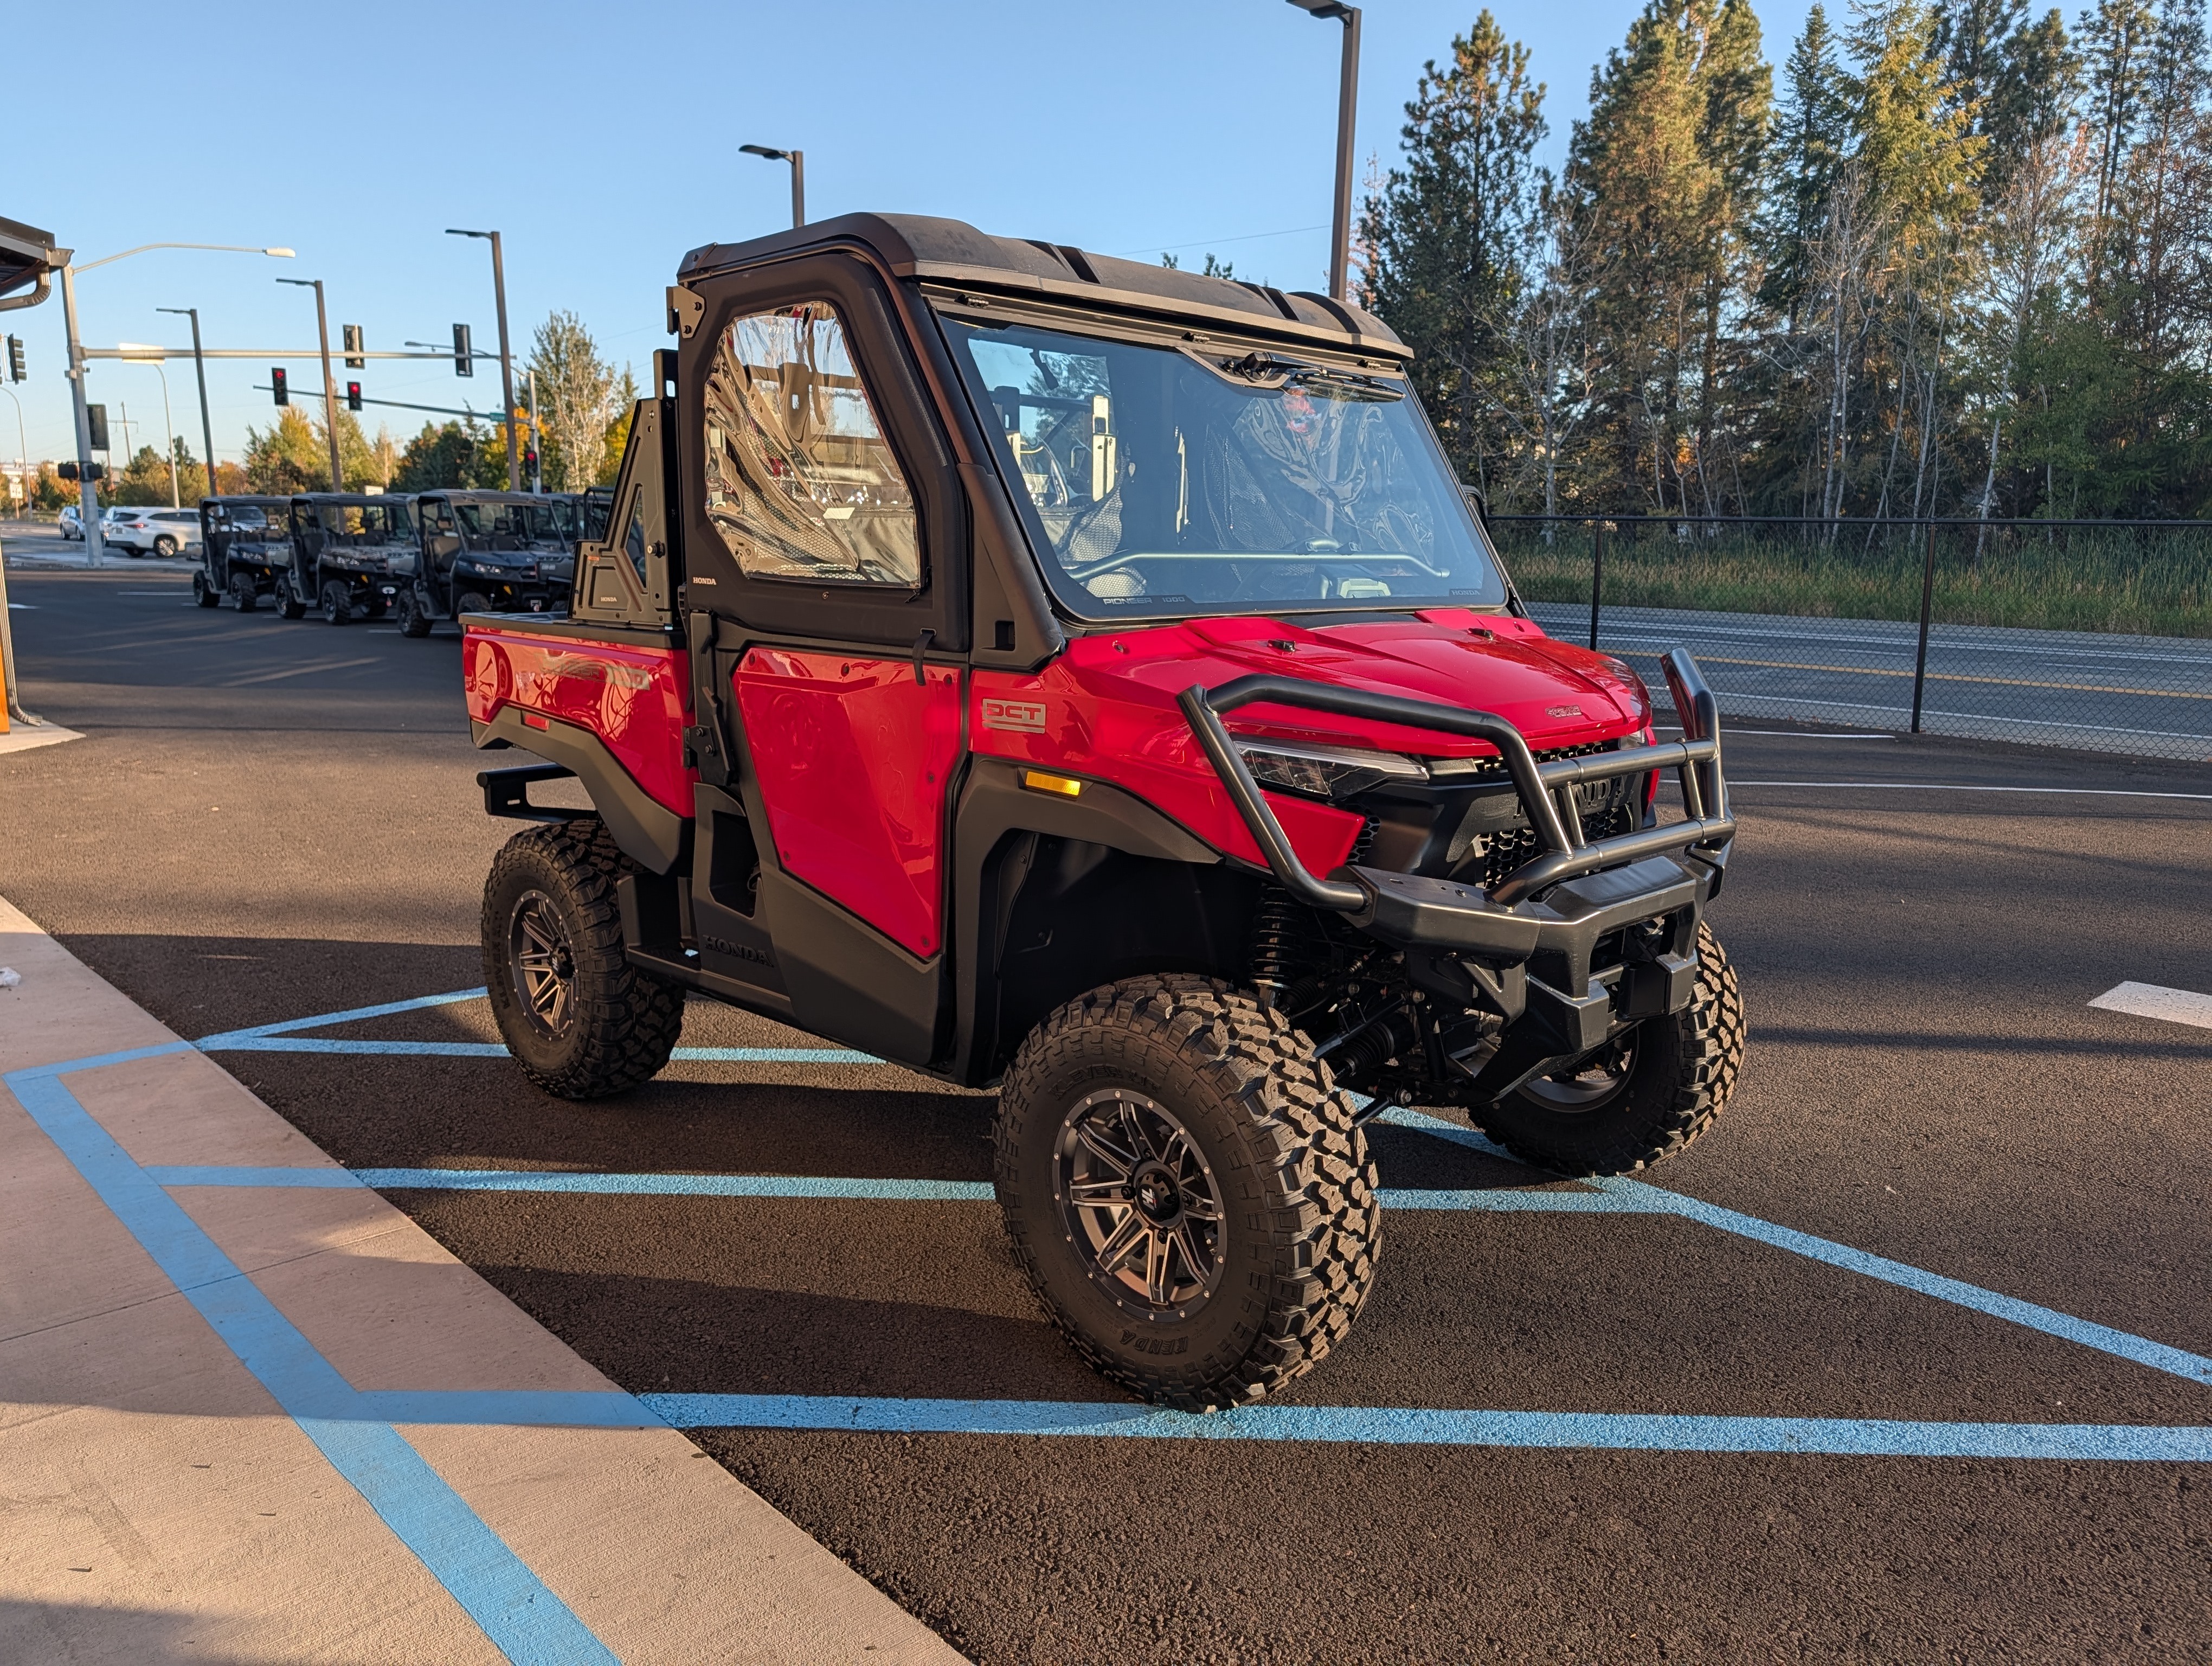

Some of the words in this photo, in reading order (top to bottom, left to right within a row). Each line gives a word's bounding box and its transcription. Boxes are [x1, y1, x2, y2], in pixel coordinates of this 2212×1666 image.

[693, 576, 717, 585] HONDA
[1103, 597, 1153, 605] PIONEER
[987, 702, 1041, 720] DCT
[703, 934, 774, 967] HONDA
[1048, 1063, 1123, 1100] KLEVER
[1119, 1330, 1188, 1354] KENDA
